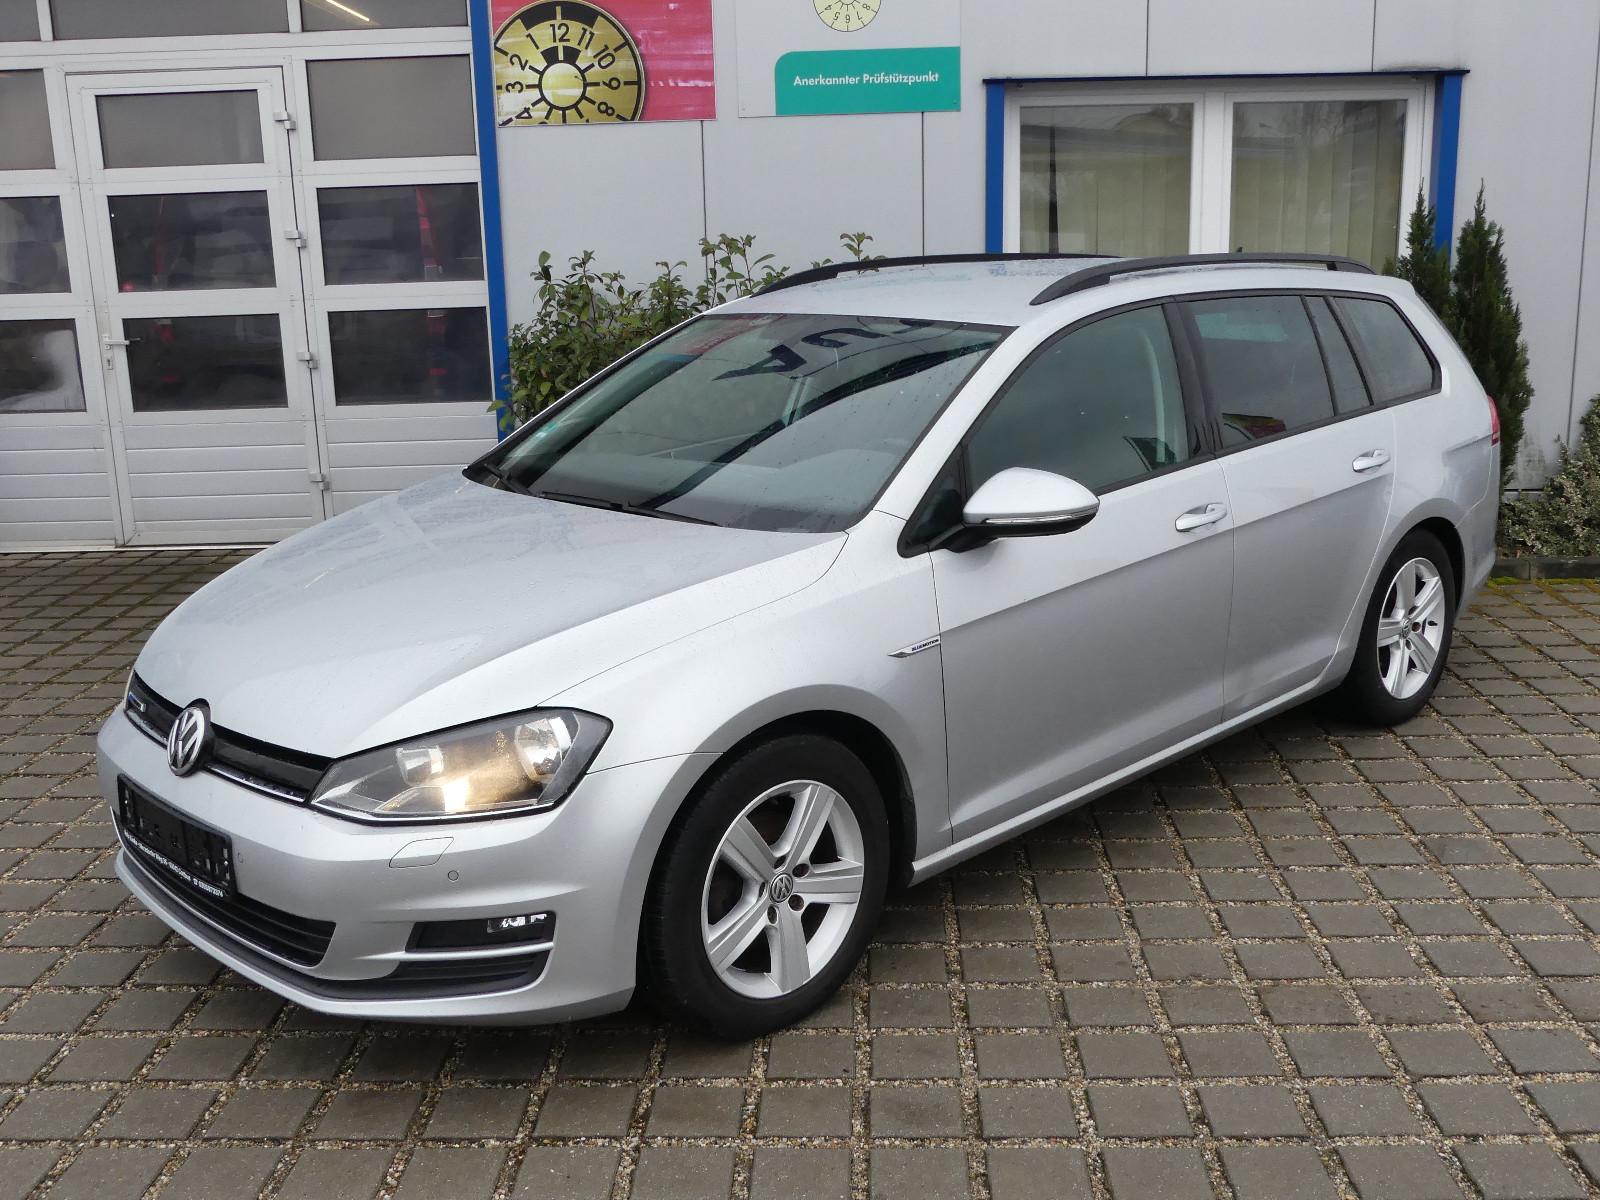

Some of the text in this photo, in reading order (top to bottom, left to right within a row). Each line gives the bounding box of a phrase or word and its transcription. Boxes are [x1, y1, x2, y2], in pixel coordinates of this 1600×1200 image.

[525, 32, 540, 50] 1
[549, 22, 571, 43] 12
[577, 27, 595, 50] 11
[509, 53, 529, 71] 2
[593, 44, 616, 70] 10
[505, 80, 524, 94] 3
[602, 77, 621, 91] 9
[793, 71, 939, 87] Anerkannter Prüfstützpunkt
[514, 106, 533, 119] 4
[597, 101, 616, 117] 8
